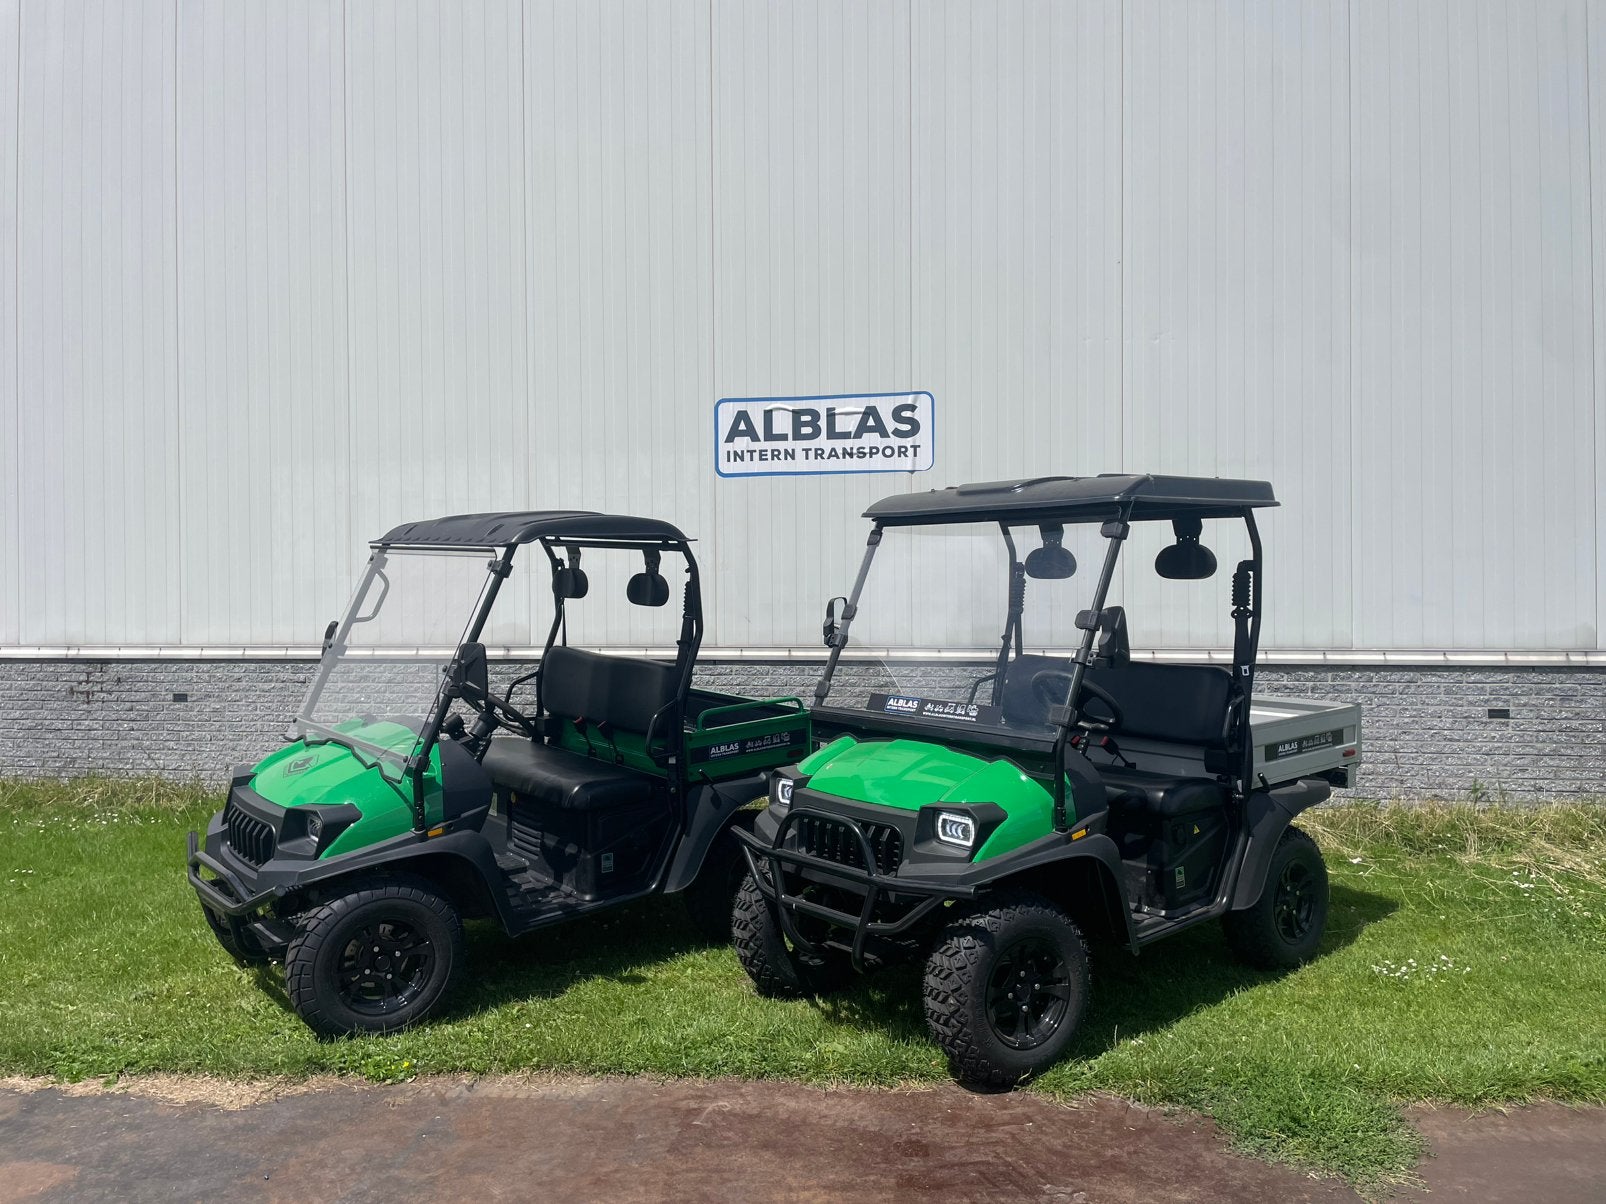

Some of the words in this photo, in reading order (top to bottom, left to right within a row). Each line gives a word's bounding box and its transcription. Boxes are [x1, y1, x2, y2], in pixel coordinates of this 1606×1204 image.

[724, 404, 921, 443] ALBLAS
[726, 448, 796, 463] INTERN
[802, 445, 921, 461] TRANSPORT
[887, 698, 918, 709] ALBLAS
[710, 743, 739, 754] ALBLAS
[1278, 742, 1298, 752] ALBLAS
